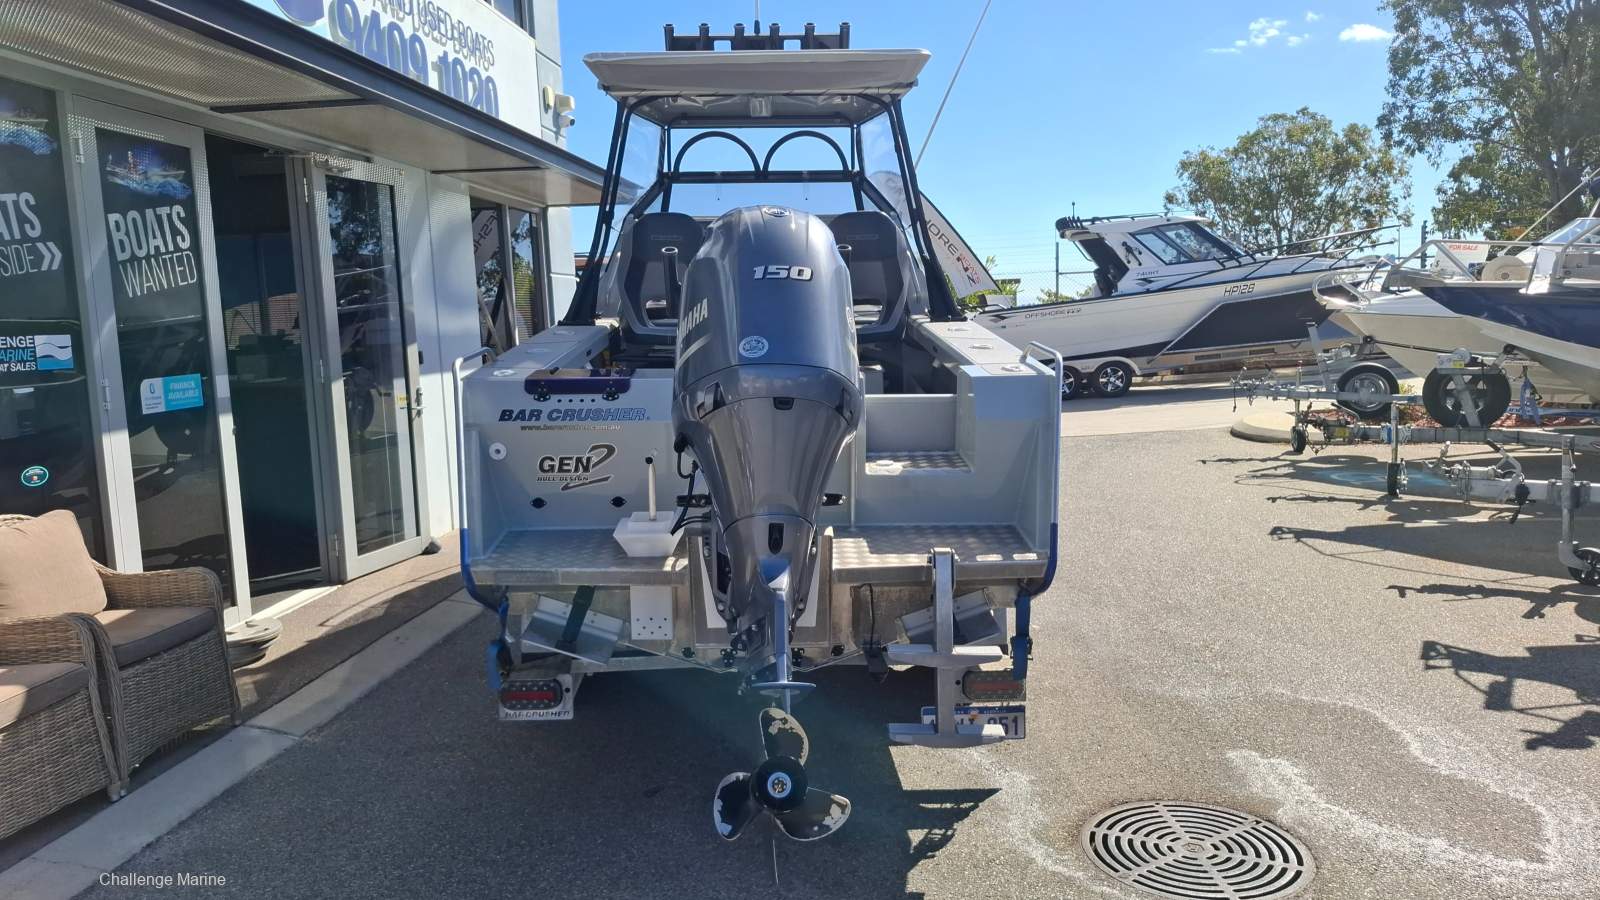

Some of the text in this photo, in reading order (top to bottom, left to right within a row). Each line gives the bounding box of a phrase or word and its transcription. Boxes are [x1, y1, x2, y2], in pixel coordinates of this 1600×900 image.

[458, 19, 495, 67] BOATS
[107, 204, 191, 262] BOATS
[119, 250, 197, 298] WANTED
[752, 265, 813, 282] 150
[0, 336, 34, 348] ENGE
[10, 361, 36, 371] SALES
[498, 409, 543, 422] BAR
[538, 455, 592, 474] GEN
